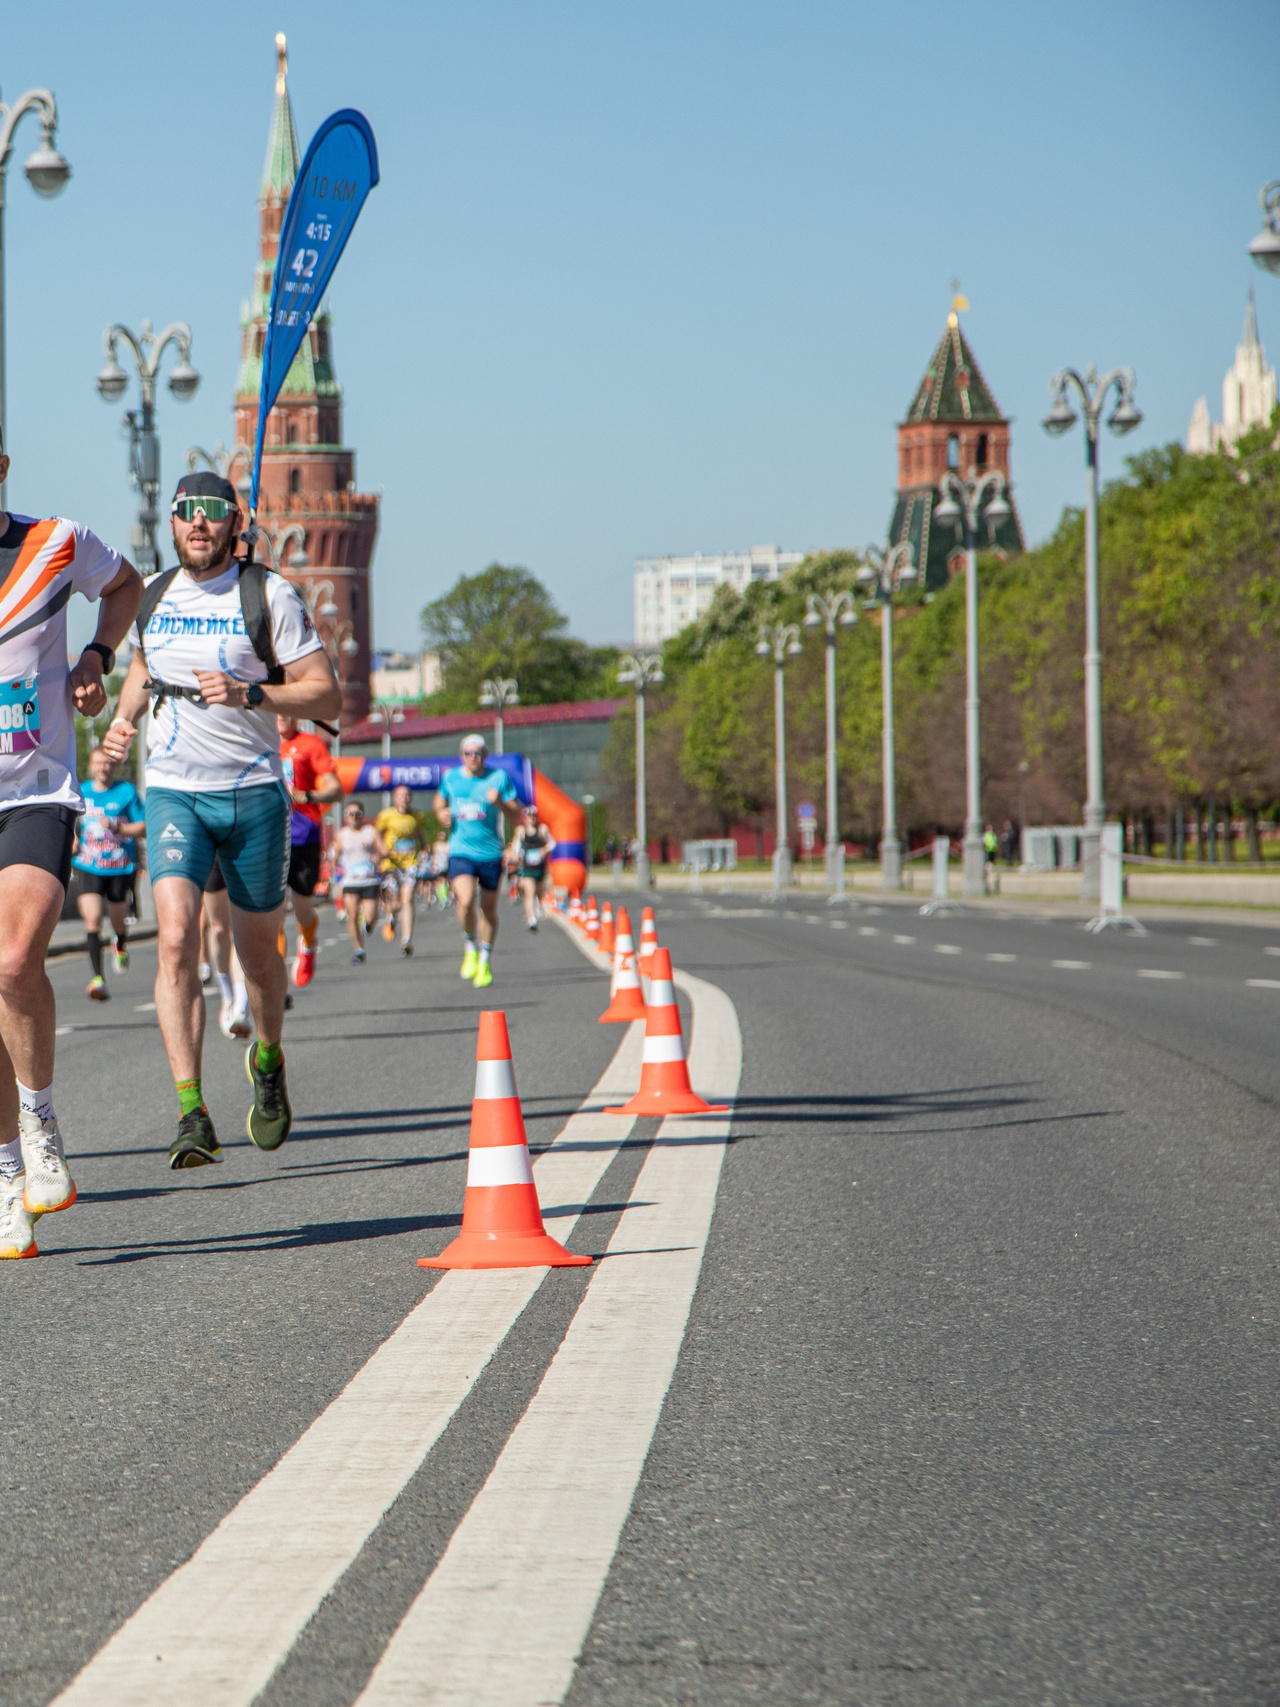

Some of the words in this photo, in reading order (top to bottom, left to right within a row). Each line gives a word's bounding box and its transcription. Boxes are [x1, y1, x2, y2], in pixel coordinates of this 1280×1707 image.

[311, 175, 330, 200] 10
[306, 222, 332, 242] 4:15
[291, 248, 319, 278] 42
[144, 612, 249, 636] ЕЙСМЕЙКЕ
[392, 766, 433, 786] ПСБ
